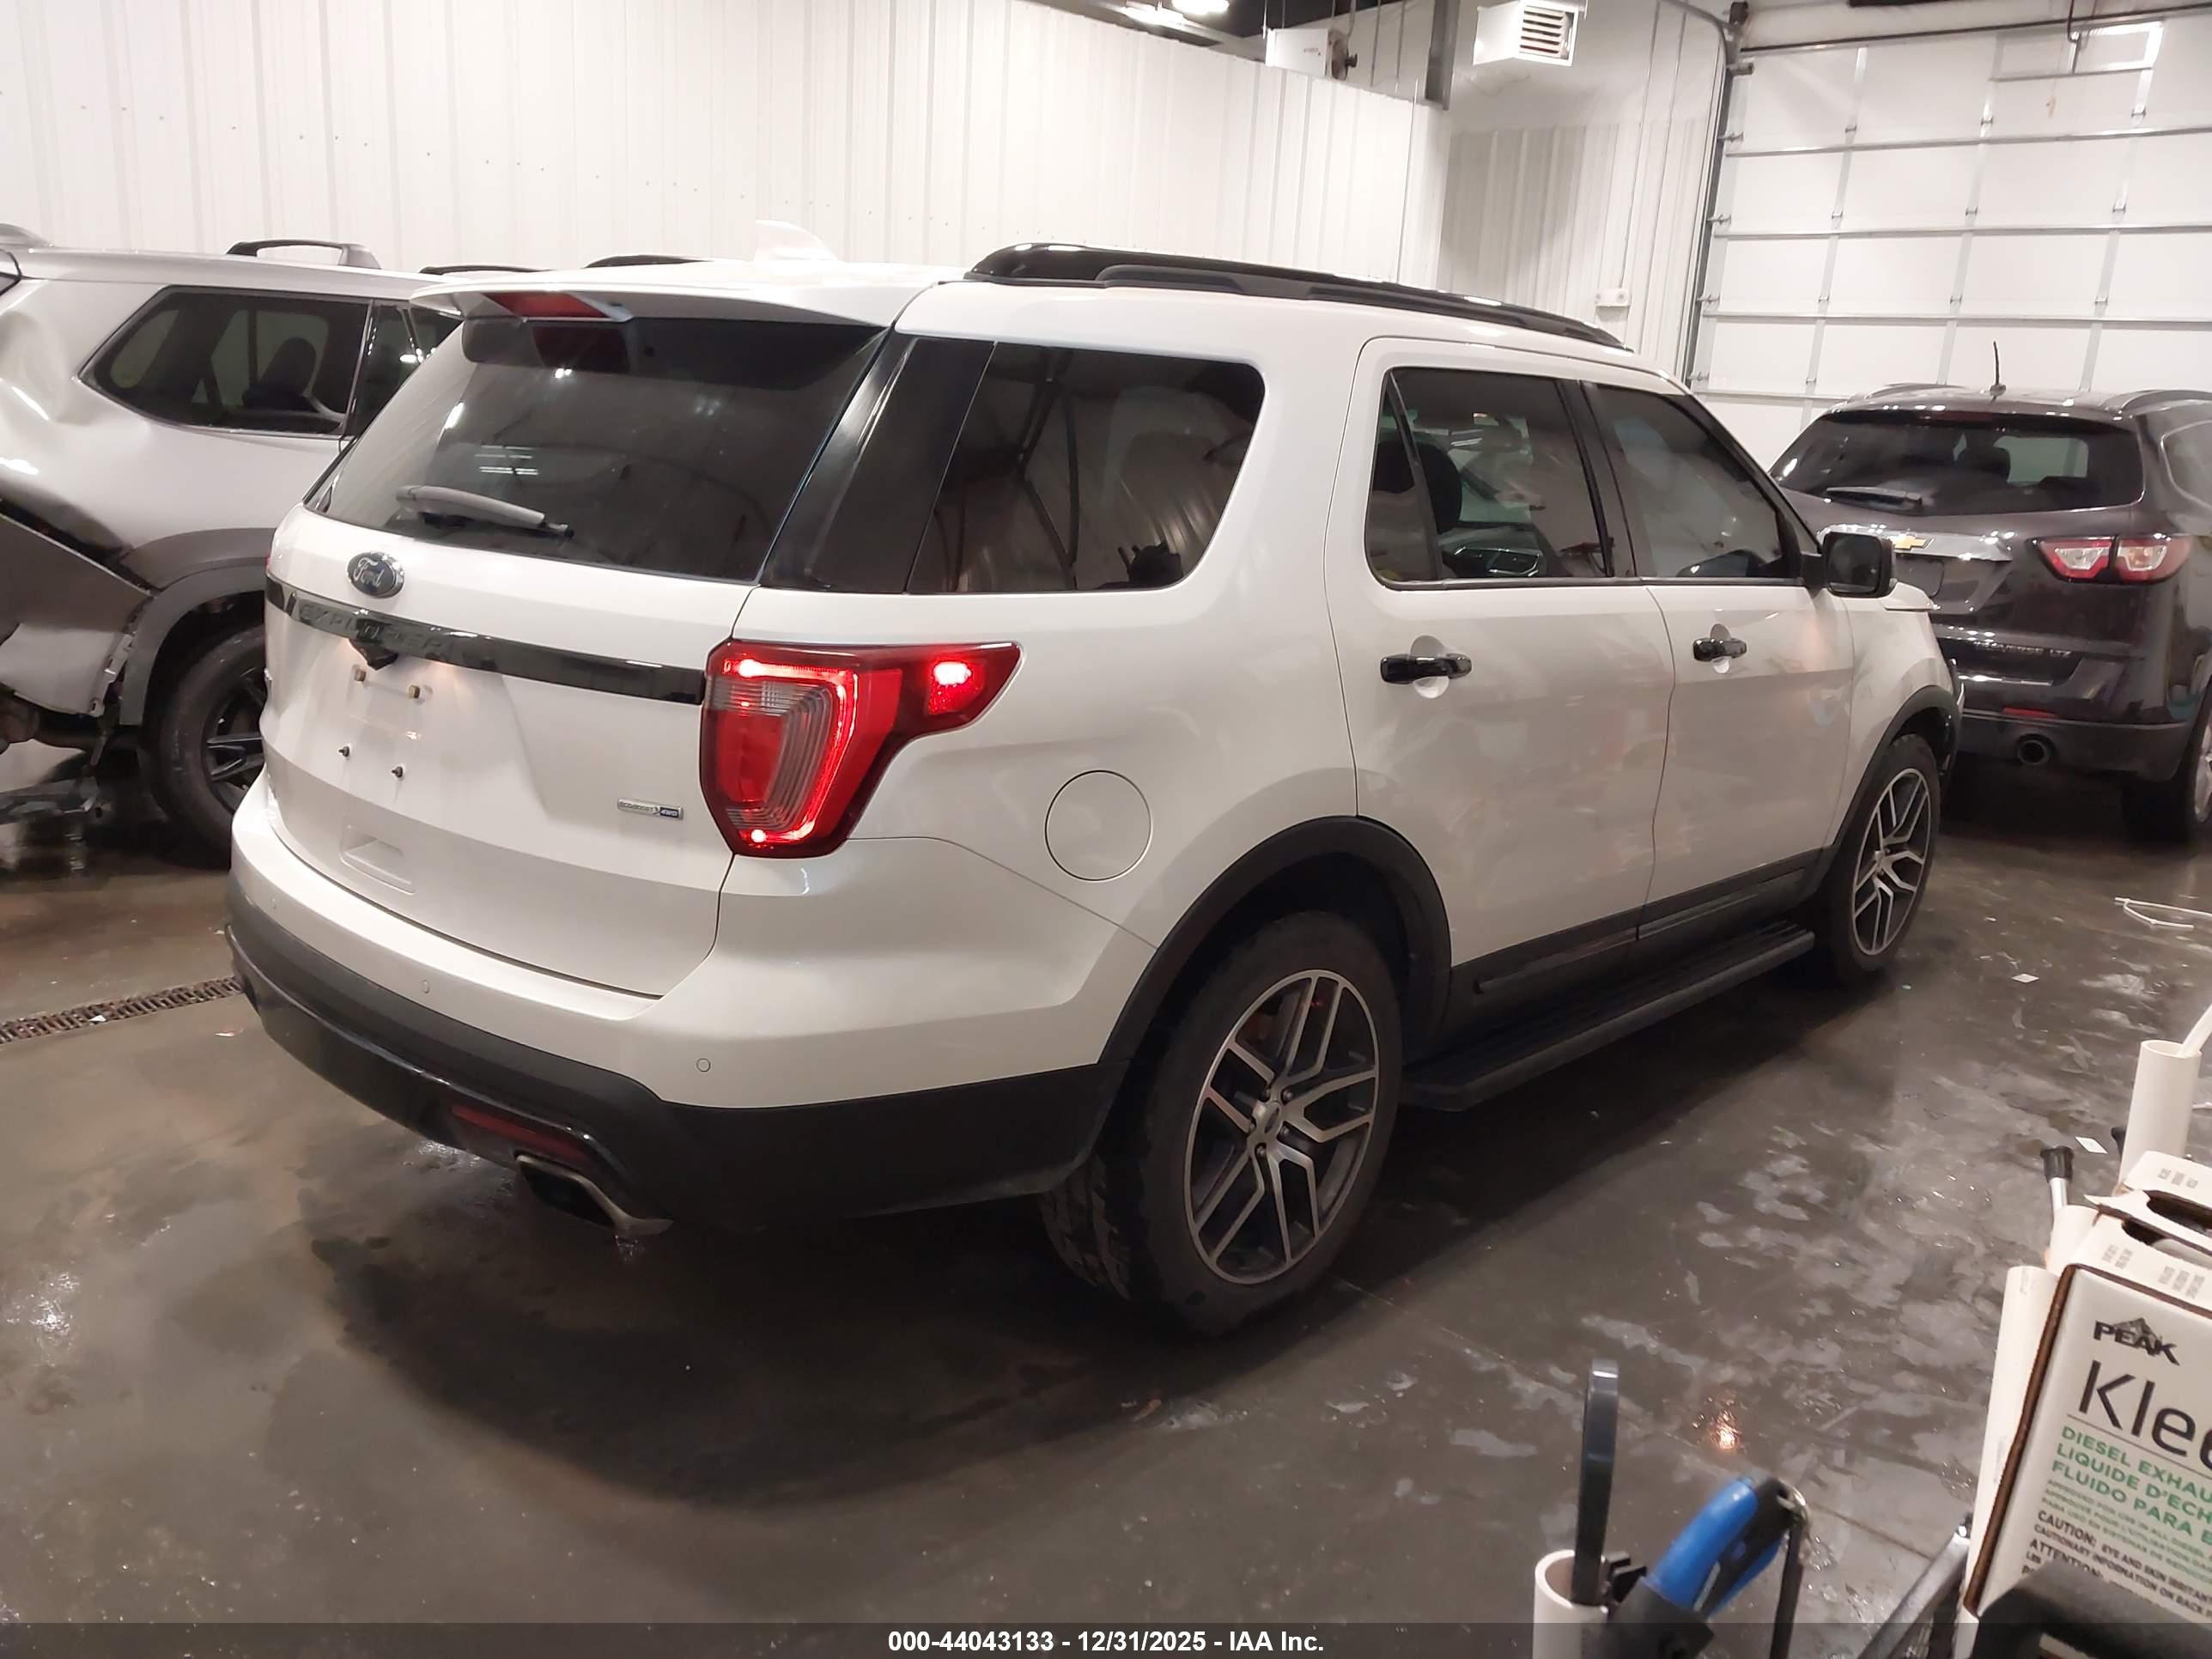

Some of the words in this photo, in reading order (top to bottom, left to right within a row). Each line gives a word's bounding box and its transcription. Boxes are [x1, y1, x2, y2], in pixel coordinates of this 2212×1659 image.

[2093, 1319, 2181, 1367] PEAK
[2079, 1359, 2212, 1471] Kle
[2057, 1443, 2140, 1490] LIQUIDE
[2062, 1426, 2131, 1467] DIESEL
[2052, 1461, 2127, 1503] FLUIDO
[2134, 1498, 2192, 1536] PARA
[2038, 1510, 2097, 1547] CAUTION:
[2092, 1549, 2158, 1592] INFORMATION
